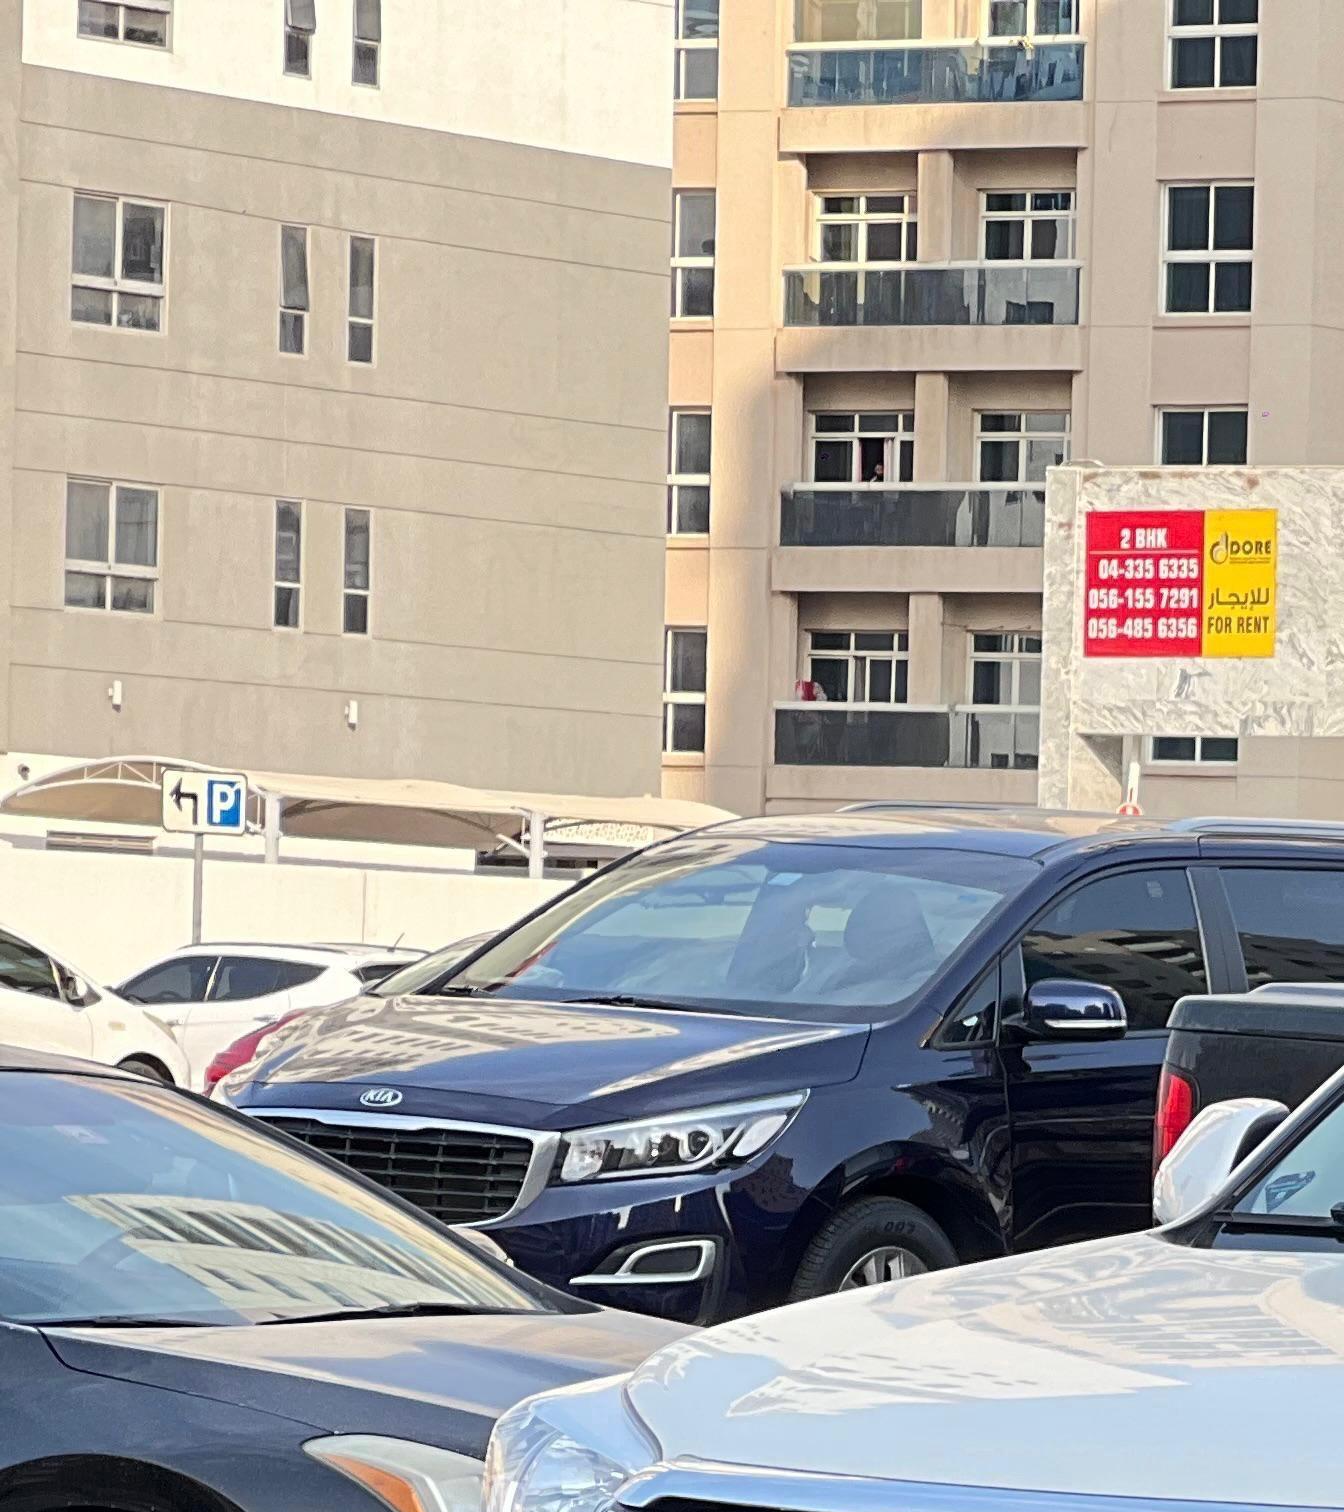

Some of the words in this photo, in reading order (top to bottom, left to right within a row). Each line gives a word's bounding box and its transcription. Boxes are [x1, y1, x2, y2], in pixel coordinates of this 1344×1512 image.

[1120, 528, 1131, 548] 2
[1135, 528, 1167, 548] BHK
[1098, 558, 1155, 580] 04-335
[1158, 558, 1199, 580] 6335
[1088, 587, 1155, 609] 056-155
[1159, 587, 1198, 609] 7291
[1157, 617, 1198, 639] 6356
[1207, 616, 1232, 634] FOR
[1236, 616, 1270, 634] RENT
[212, 784, 242, 824] P
[363, 1089, 397, 1104] KIA
